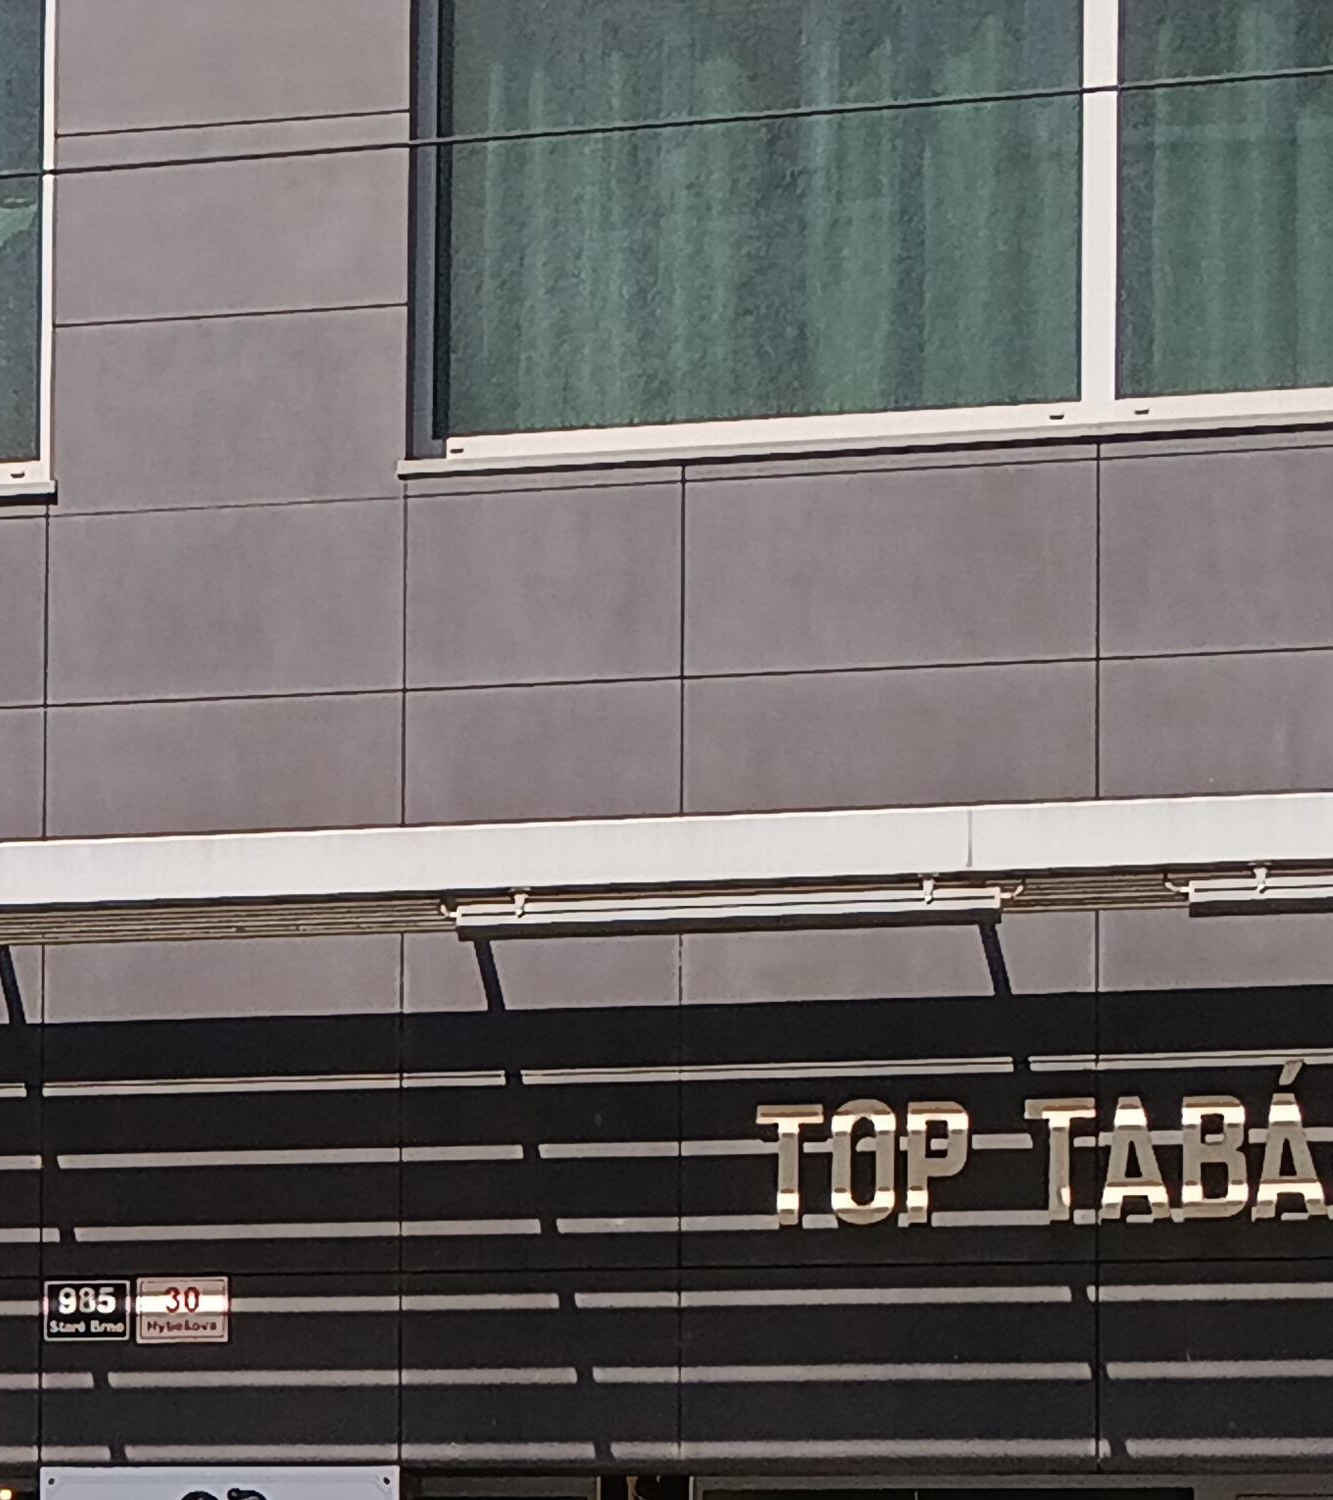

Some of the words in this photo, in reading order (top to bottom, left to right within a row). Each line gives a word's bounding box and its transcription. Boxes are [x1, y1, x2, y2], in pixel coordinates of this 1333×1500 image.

[756, 1099, 968, 1226] TOP
[1024, 1058, 1325, 1223] TABÁ
[58, 1287, 116, 1314] 985
[165, 1287, 200, 1313] 30
[90, 1320, 124, 1333] Brno
